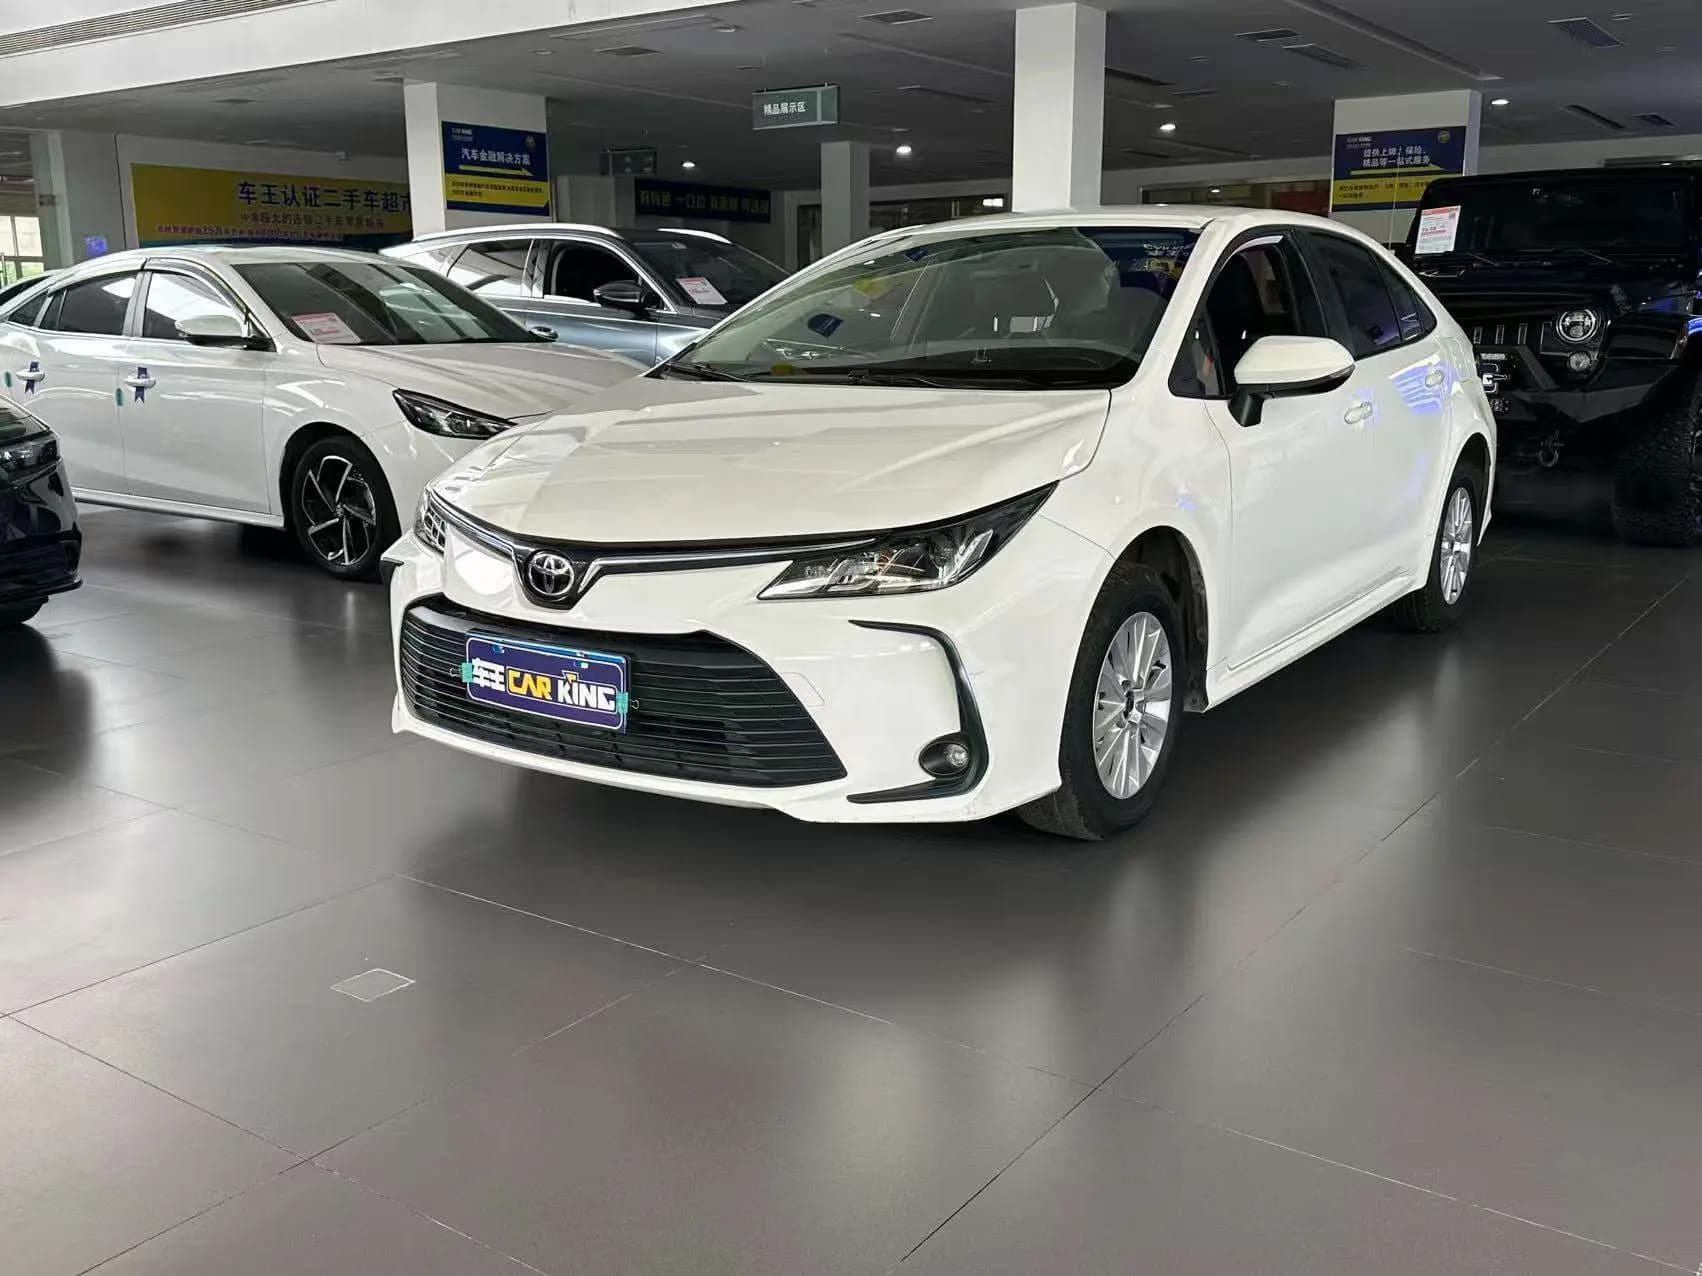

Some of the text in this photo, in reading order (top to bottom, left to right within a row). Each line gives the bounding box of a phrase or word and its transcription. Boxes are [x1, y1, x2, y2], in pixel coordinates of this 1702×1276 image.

[763, 101, 806, 116] 精品展示区
[461, 147, 531, 166] 汽车金融解决方案
[507, 670, 553, 701] CAR
[557, 673, 616, 711] KING
